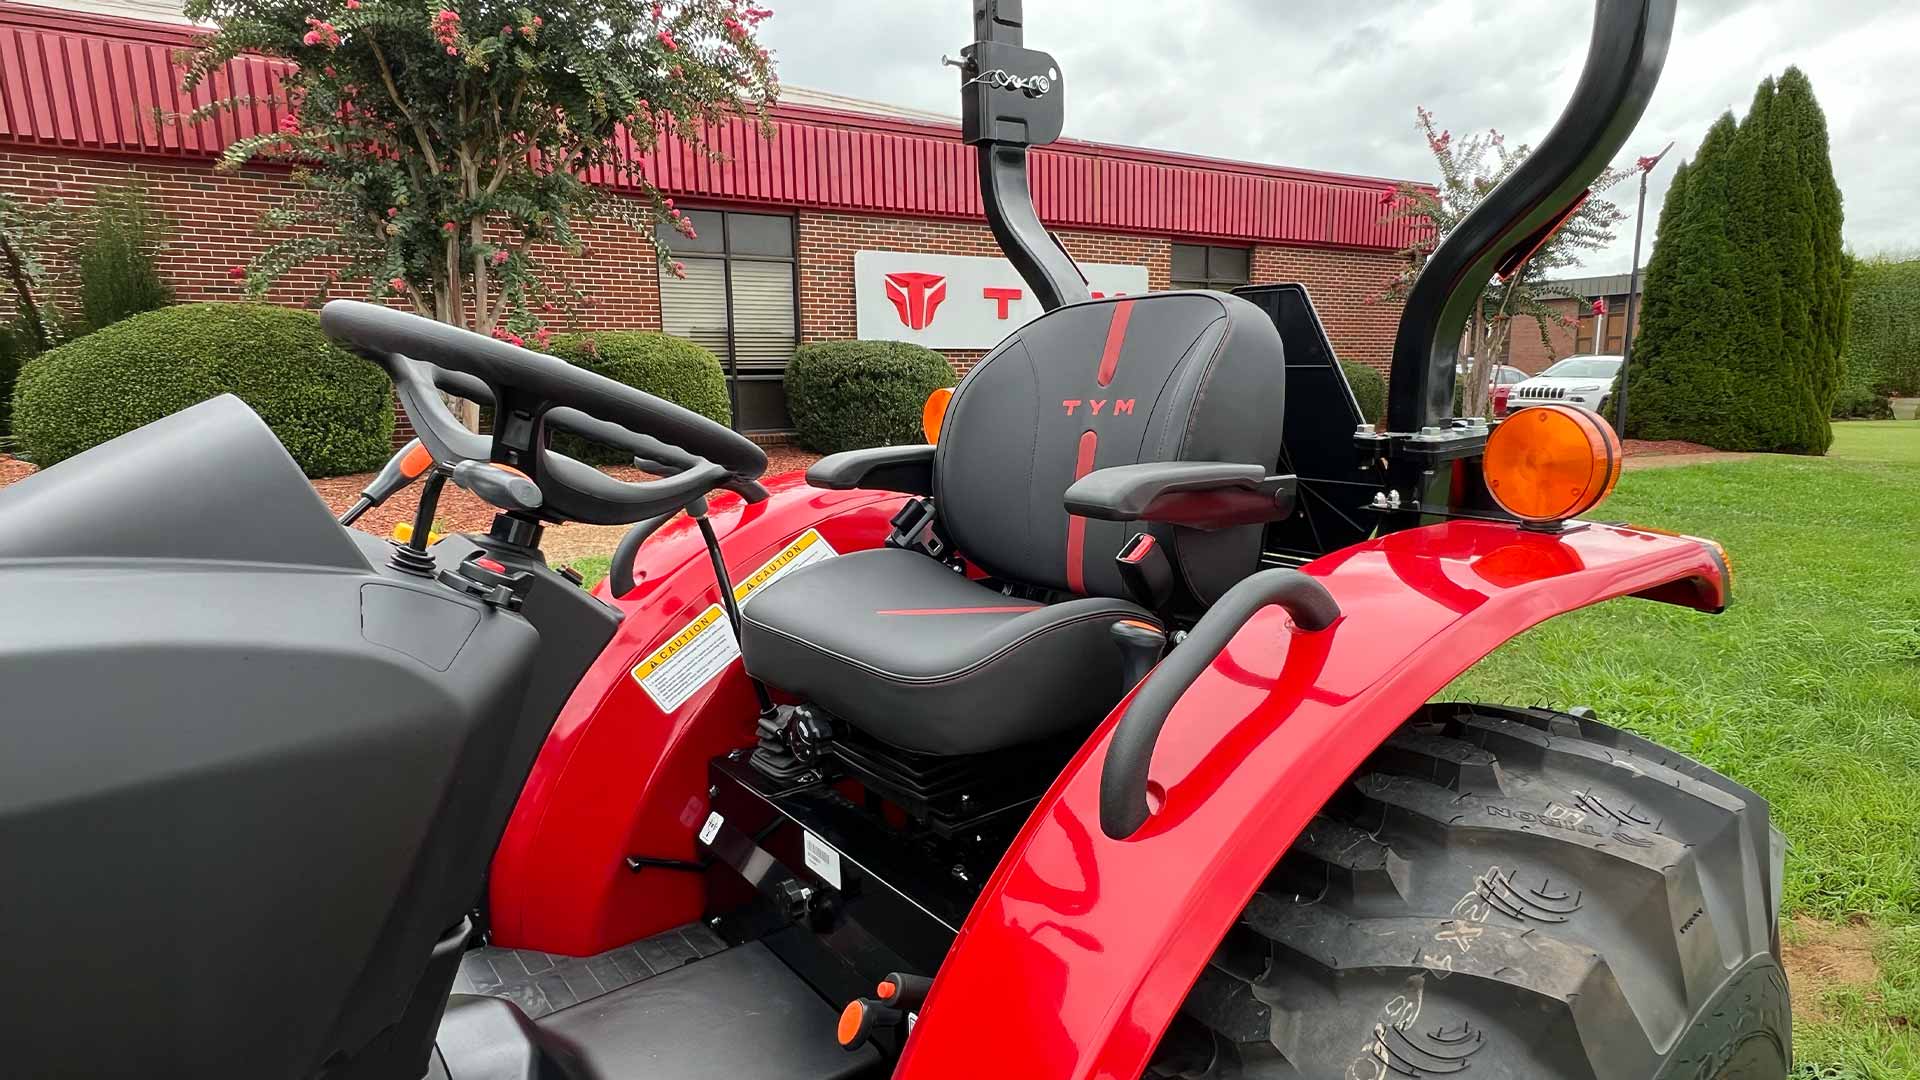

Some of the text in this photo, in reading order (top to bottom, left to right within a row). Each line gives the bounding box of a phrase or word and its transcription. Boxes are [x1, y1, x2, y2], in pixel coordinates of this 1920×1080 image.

[1062, 399, 1136, 416] TYM
[755, 545, 801, 583] CAUTION
[660, 617, 709, 660] CAUTION
